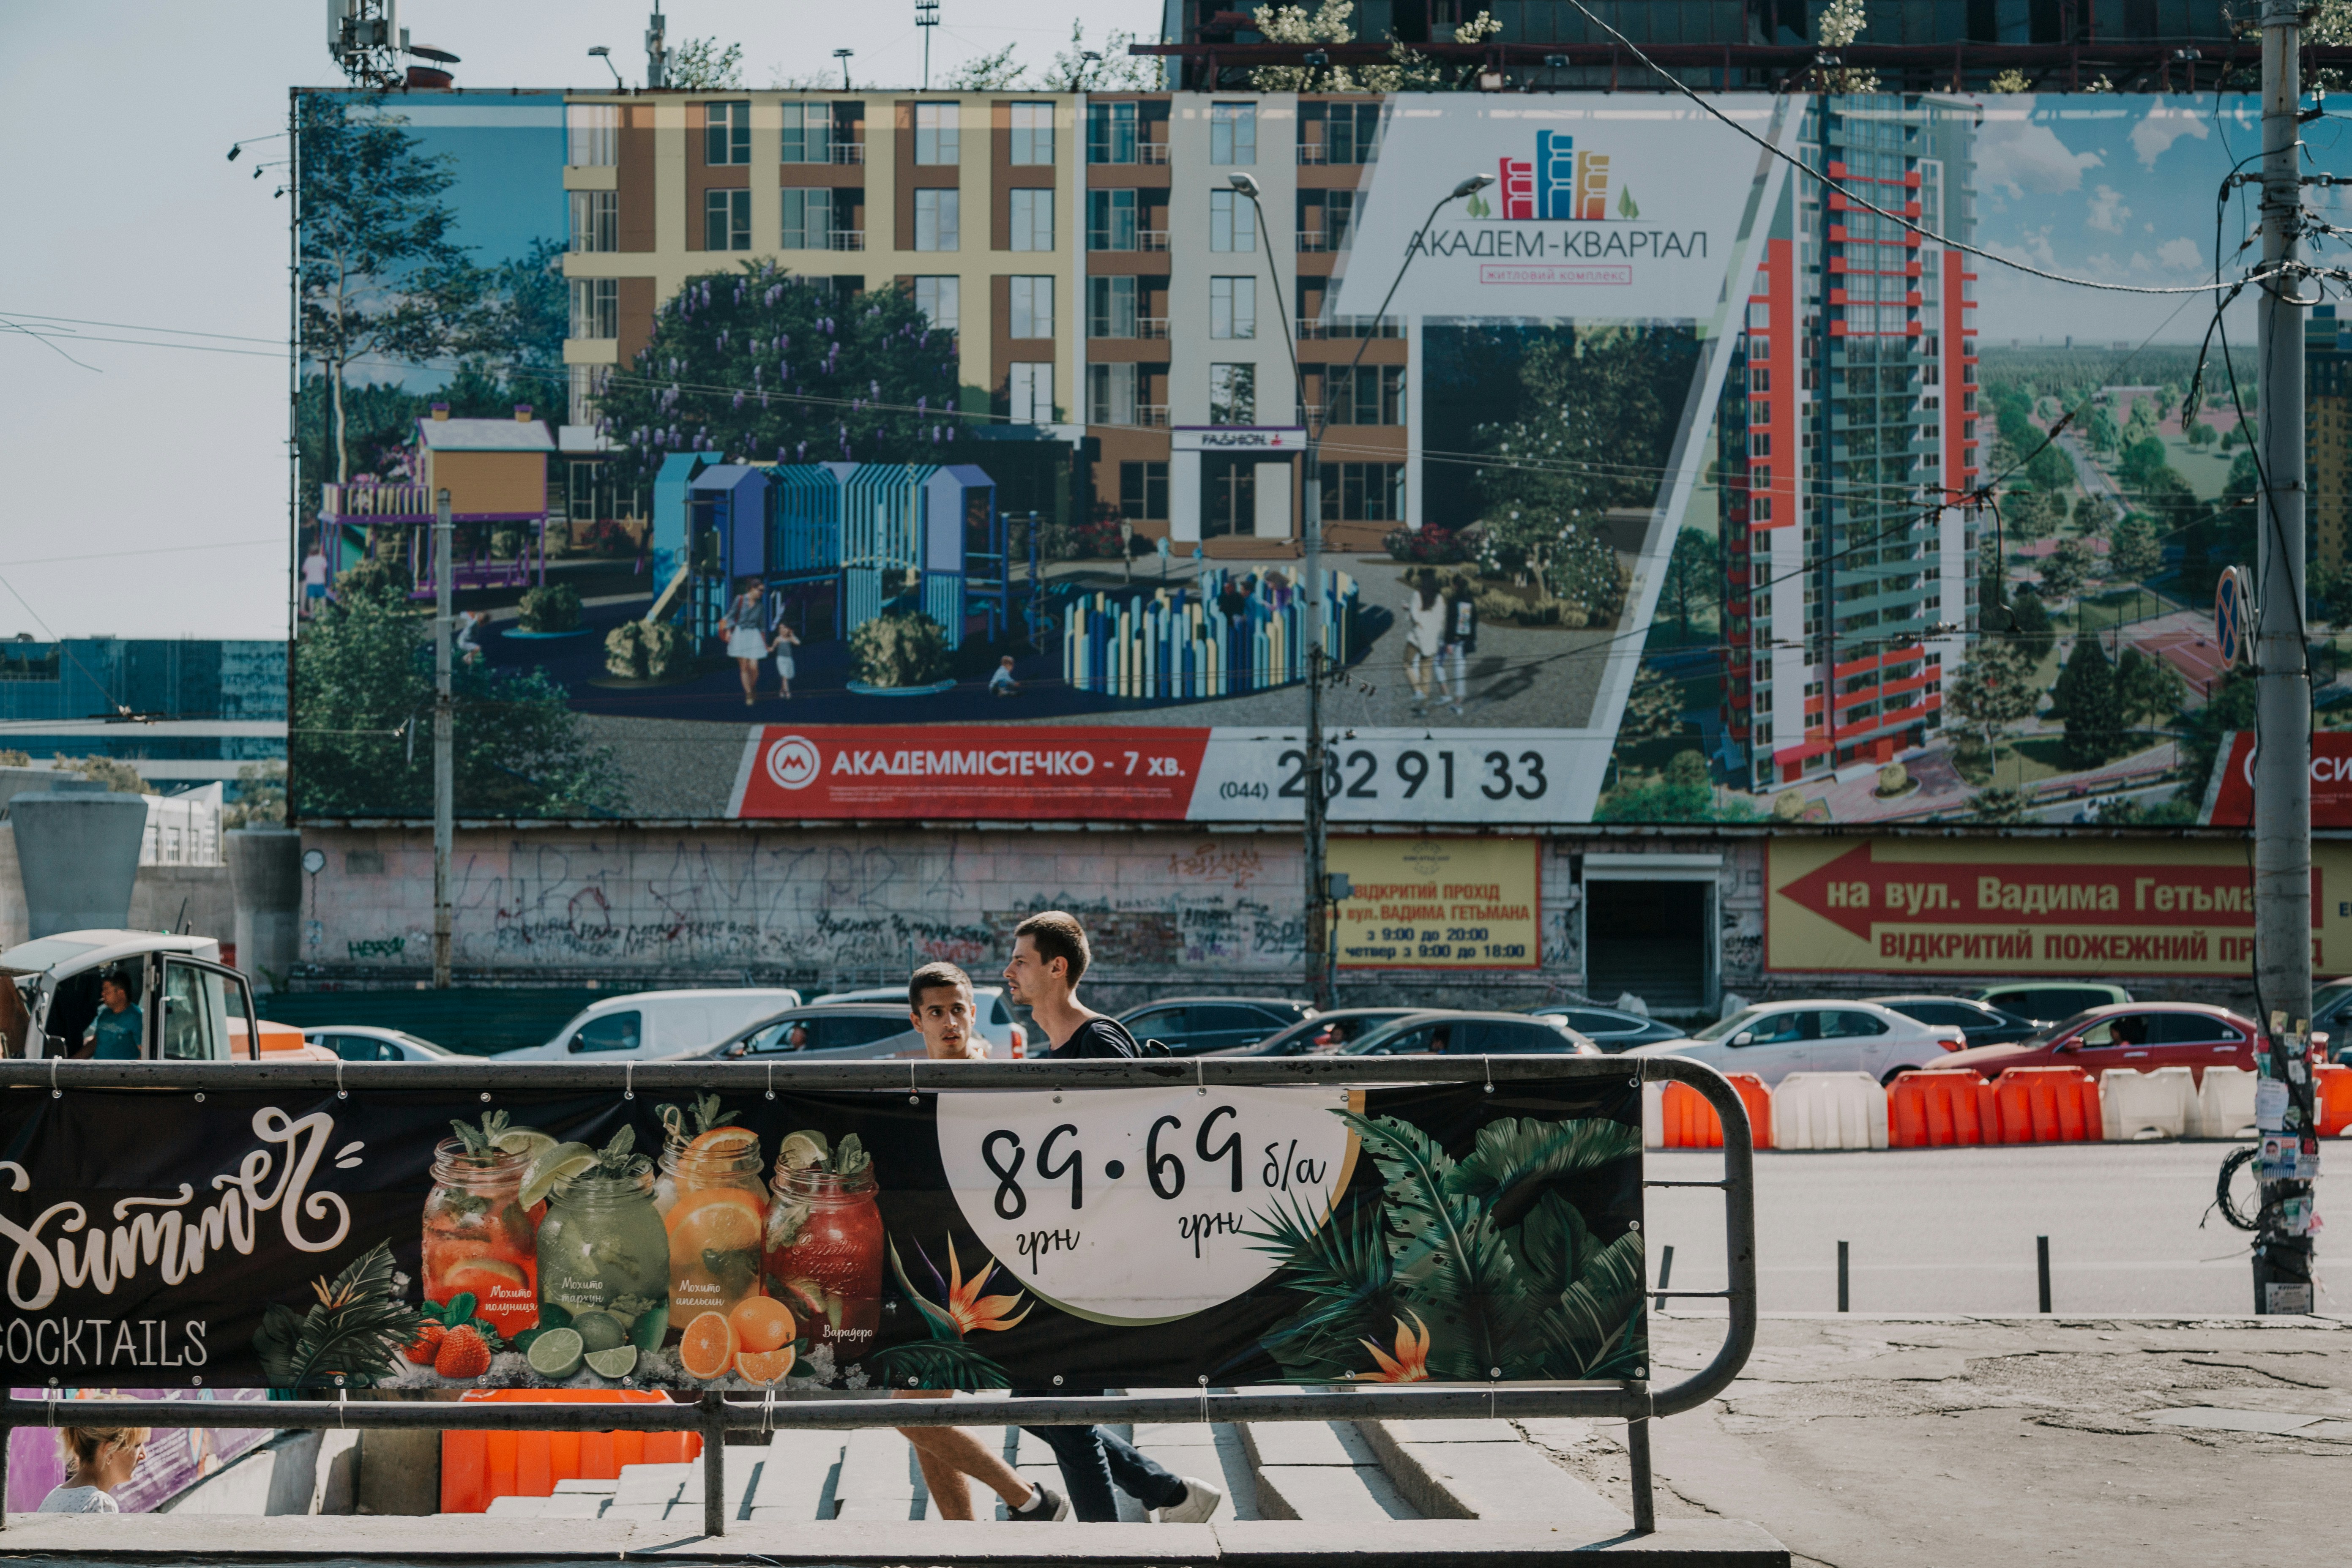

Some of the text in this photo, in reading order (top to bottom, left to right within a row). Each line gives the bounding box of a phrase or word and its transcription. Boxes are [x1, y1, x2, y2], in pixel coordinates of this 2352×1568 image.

[1405, 230, 1707, 258] АКАДЕМ-КВАРТАЛ
[830, 750, 1094, 776] АКАДЕММІСТЕЧКО
[1123, 751, 1139, 775] 7
[1147, 757, 1186, 777] хв.
[1219, 781, 1268, 800] (044)
[1396, 750, 1454, 798] 91
[1481, 750, 1548, 800] 33
[1354, 881, 1500, 902] ВІДКРИТИЙ ПРОХІД
[1827, 881, 1870, 908] на
[1885, 882, 1961, 916] вул.
[1977, 876, 2120, 915] Вадима
[1347, 908, 1379, 923] вул.
[1381, 905, 1445, 923] ВАДИМА
[1451, 905, 1530, 921] ГЕТЬМАНА
[1382, 927, 1415, 941] 9:00
[1447, 928, 1489, 942] 20:00
[1418, 944, 1451, 958] 9:00
[1484, 944, 1526, 958] 18:00
[1880, 929, 2032, 963] ВІДКРИТИЙ
[2044, 930, 2208, 961] ПОЖЕЖНИЙ
[1178, 1212, 1243, 1259] грн
[1016, 1228, 1080, 1275] грн
[489, 1285, 532, 1298] Мохито
[561, 1276, 603, 1290] Мохито
[679, 1279, 721, 1293] Мохито
[485, 1302, 538, 1316] полуниця
[561, 1294, 604, 1309] тархун
[676, 1297, 725, 1307] апельсин
[0, 1317, 208, 1366] OCKTAILS
[822, 1324, 873, 1343] Варадеро
